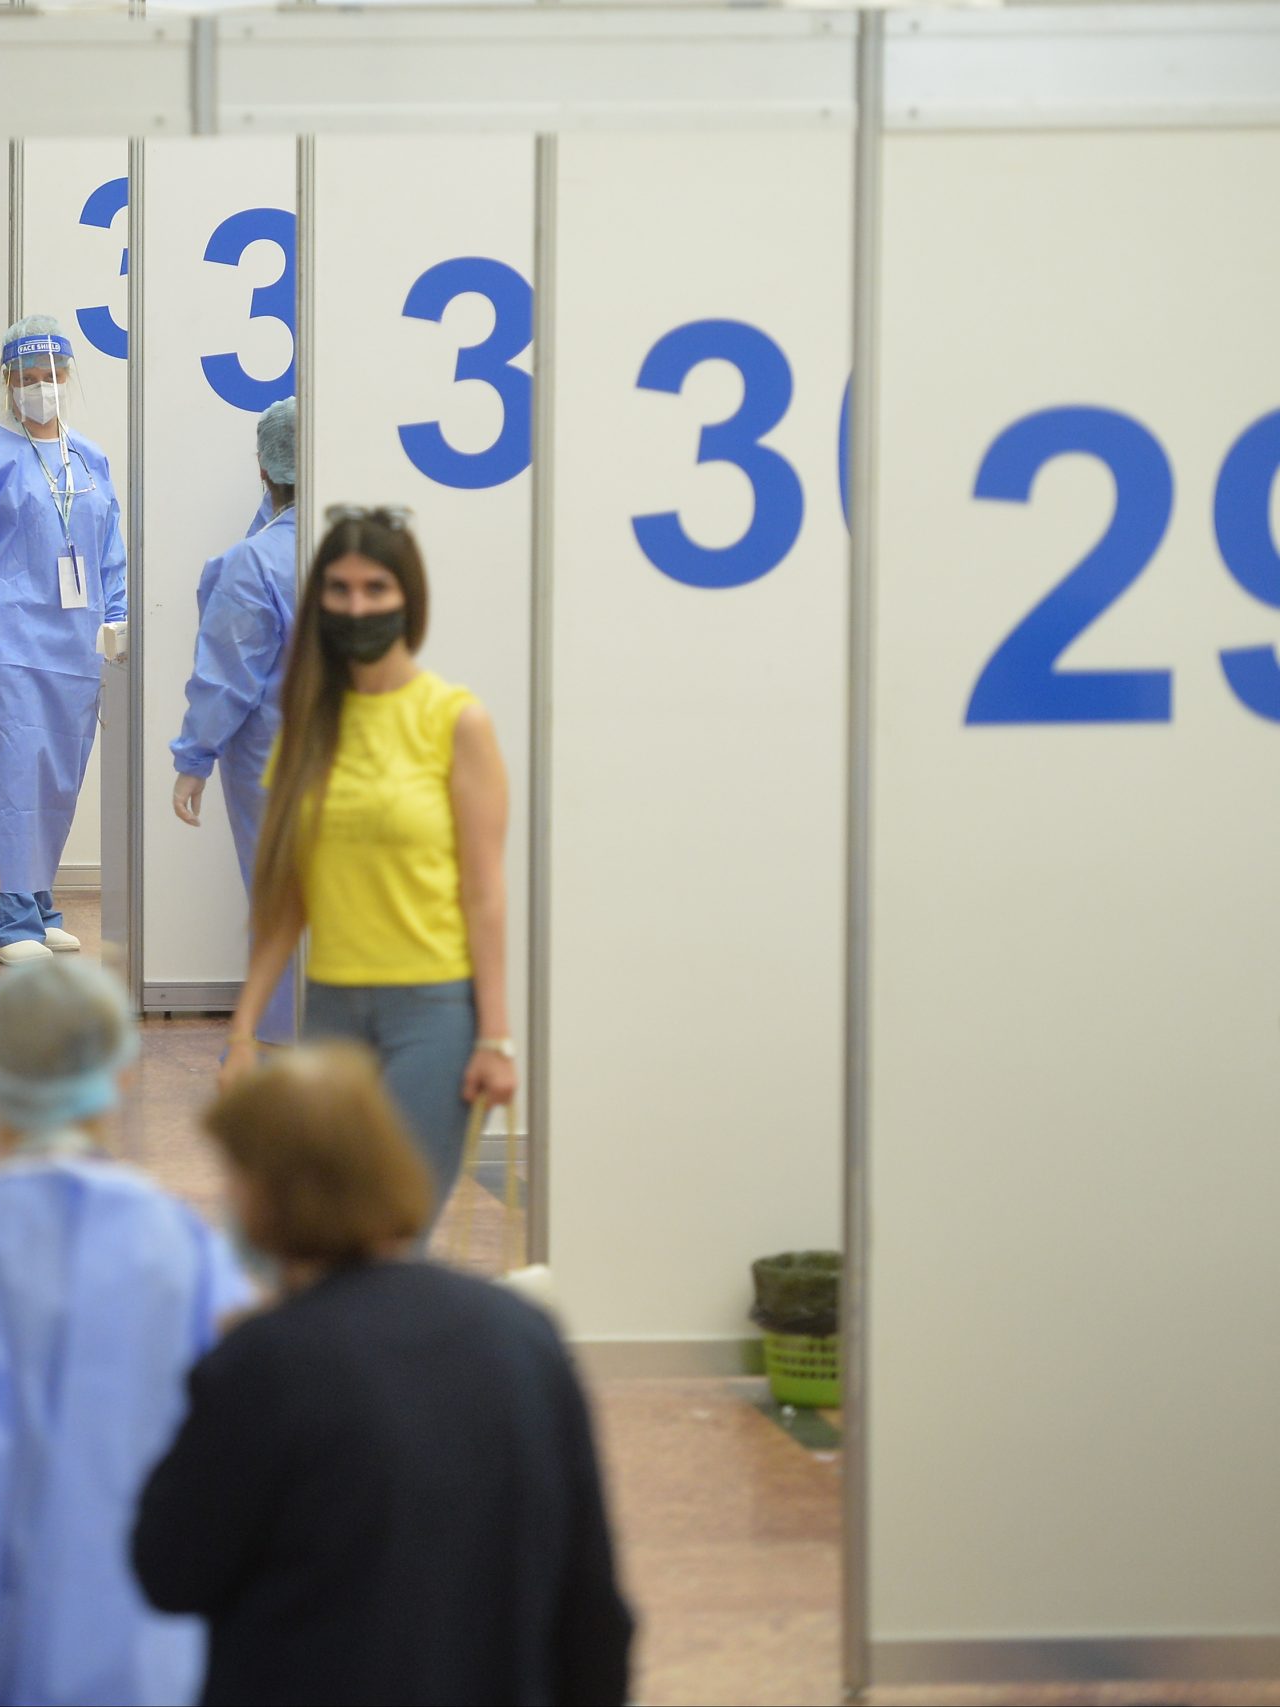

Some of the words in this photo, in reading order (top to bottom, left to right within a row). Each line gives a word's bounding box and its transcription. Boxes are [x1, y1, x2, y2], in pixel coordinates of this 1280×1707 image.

[19, 344, 35, 352] FACE
[36, 342, 59, 351] SHILD
[397, 256, 534, 489] 3
[632, 318, 852, 589] 3
